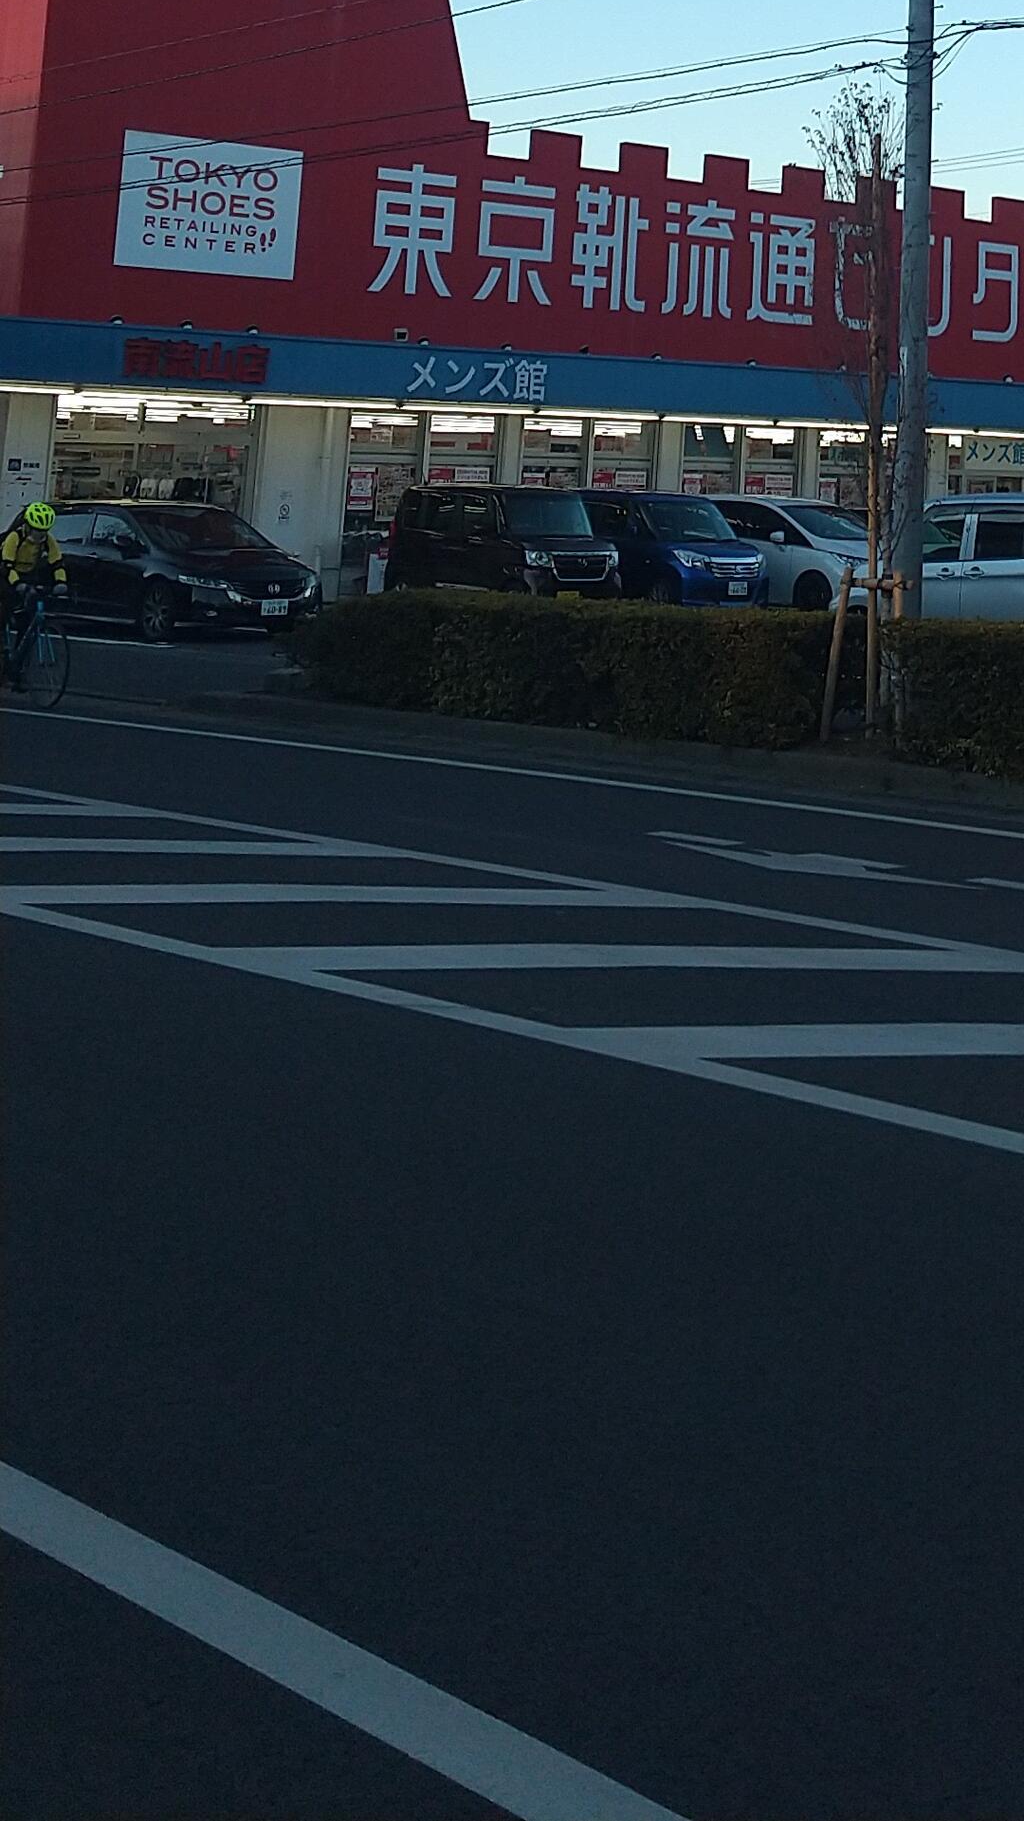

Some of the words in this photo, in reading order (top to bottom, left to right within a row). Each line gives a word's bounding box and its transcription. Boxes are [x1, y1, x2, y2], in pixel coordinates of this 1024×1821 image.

[150, 156, 278, 191] TOKYO
[145, 185, 275, 221] SHOES
[144, 215, 258, 238] RETAILING
[406, 356, 548, 402] メンズ館
